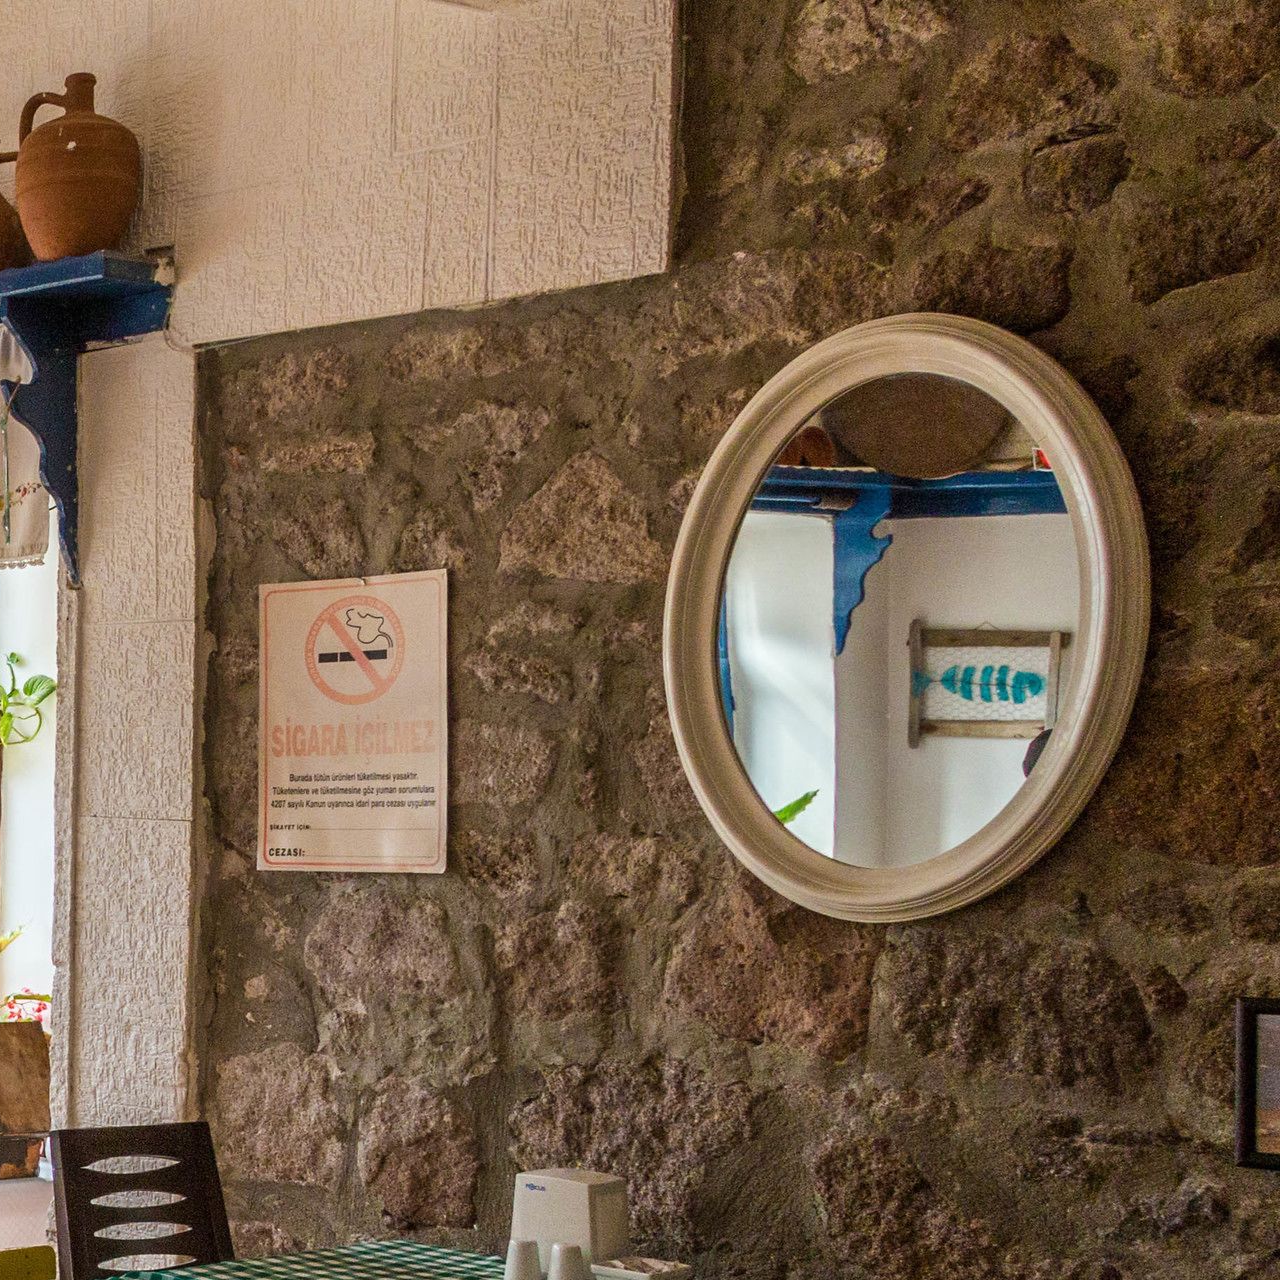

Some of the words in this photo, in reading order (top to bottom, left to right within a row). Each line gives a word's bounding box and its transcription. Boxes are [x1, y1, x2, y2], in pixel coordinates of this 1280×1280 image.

[271, 718, 349, 758] SİGARA
[289, 773, 313, 782] Burada
[313, 773, 331, 782] tütün
[331, 773, 356, 782] ürünleri
[357, 772, 391, 781] tüketilmesi
[362, 786, 374, 796] göz
[305, 800, 326, 808] Kanun
[371, 801, 385, 809] para
[268, 848, 306, 857] CEZASI:
